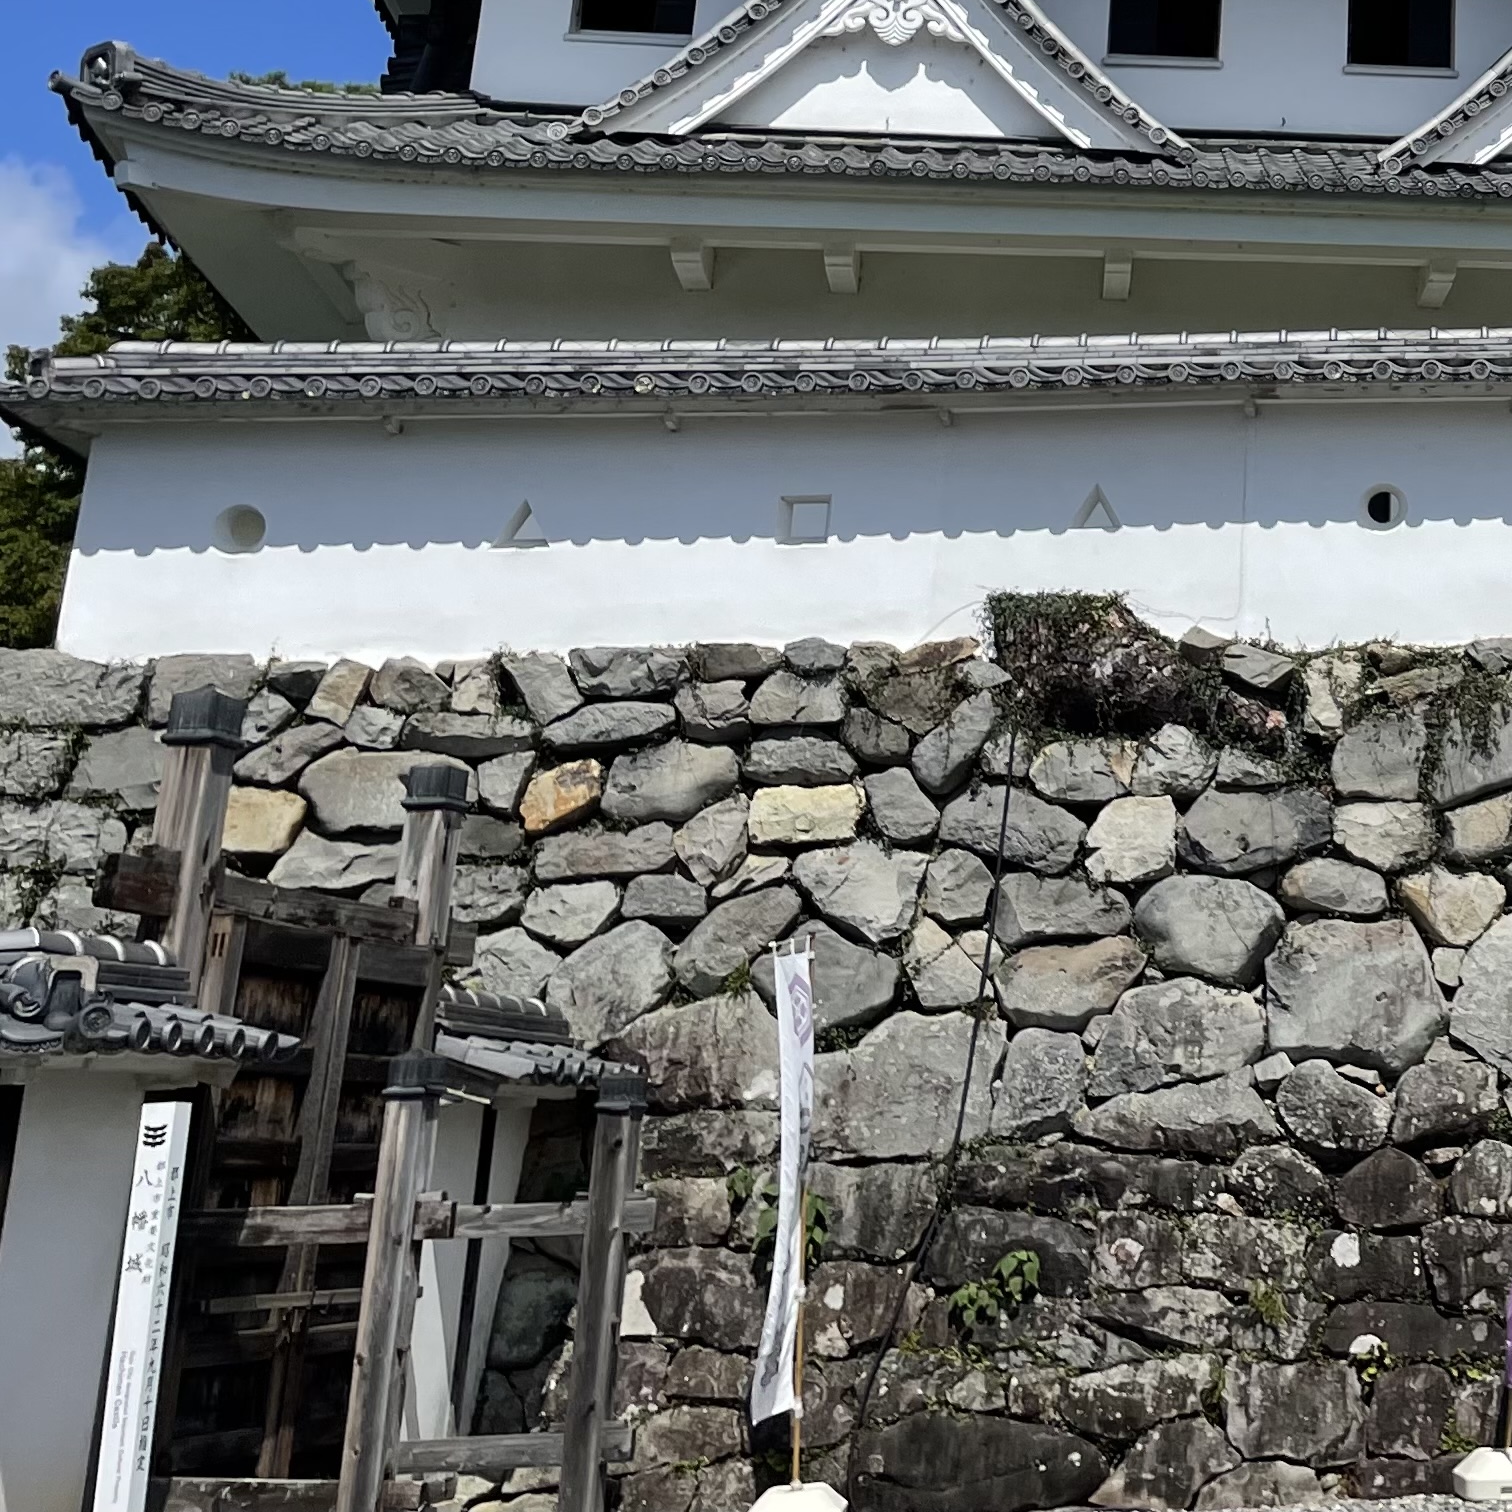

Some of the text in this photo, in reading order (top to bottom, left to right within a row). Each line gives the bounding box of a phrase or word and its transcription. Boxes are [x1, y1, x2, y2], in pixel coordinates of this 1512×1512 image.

[125, 1169, 153, 1273] 八幡城
[111, 1397, 123, 1430] Castle
